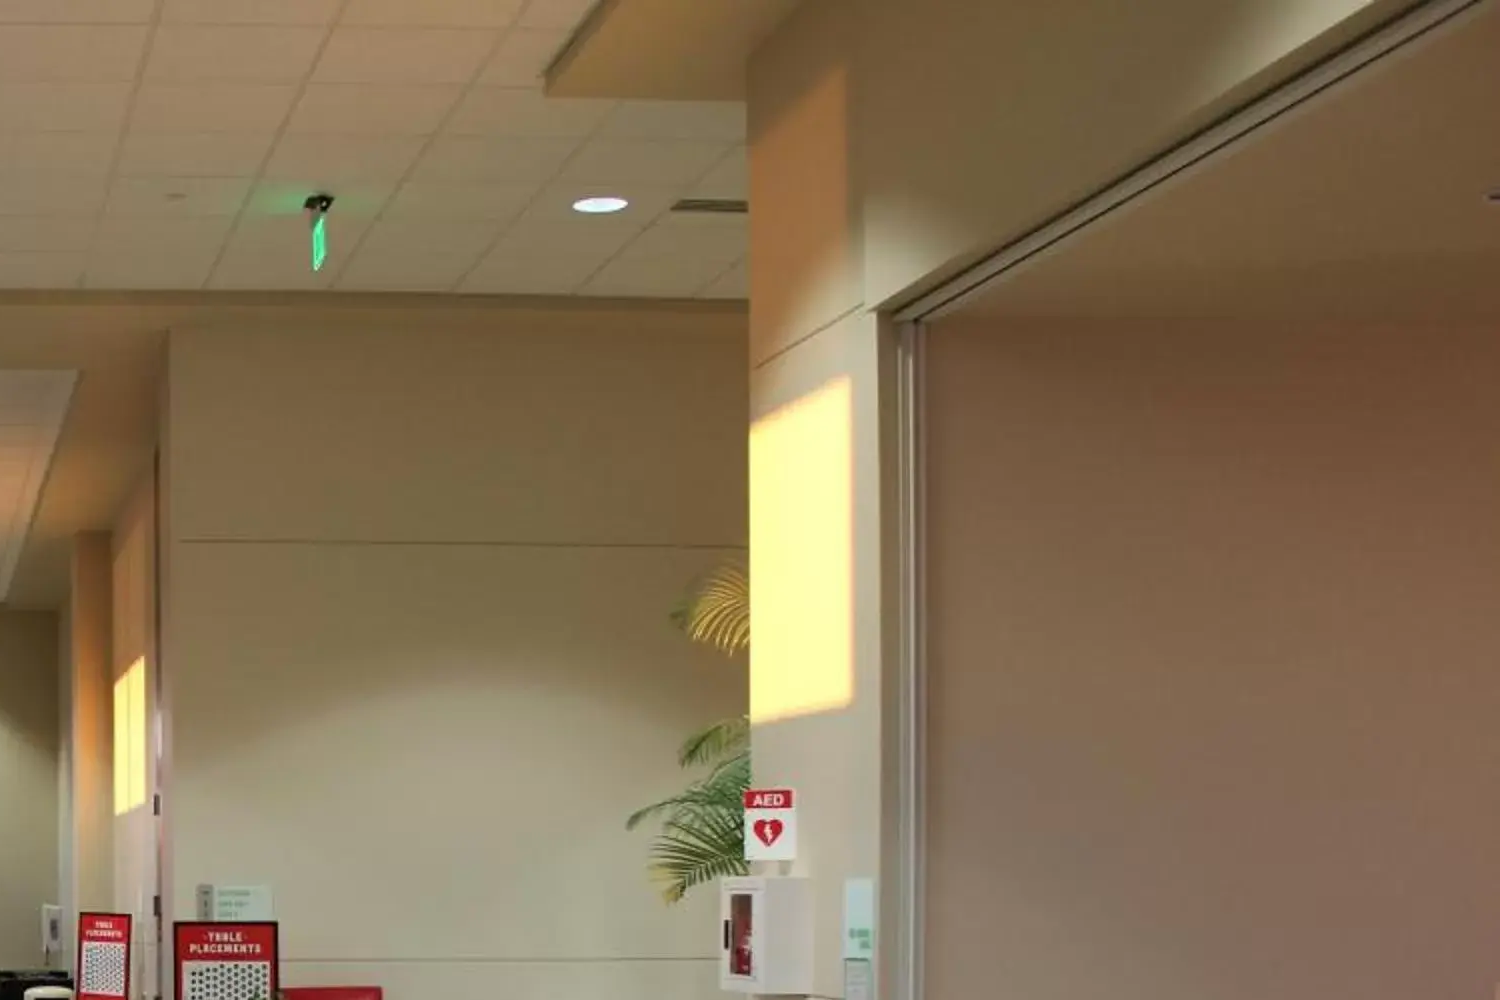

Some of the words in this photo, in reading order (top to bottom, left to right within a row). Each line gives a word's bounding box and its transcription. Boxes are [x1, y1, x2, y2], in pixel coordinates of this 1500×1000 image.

[753, 793, 784, 807] AED
[207, 931, 243, 943] TABLE
[189, 943, 261, 954] PLACEMENTS
